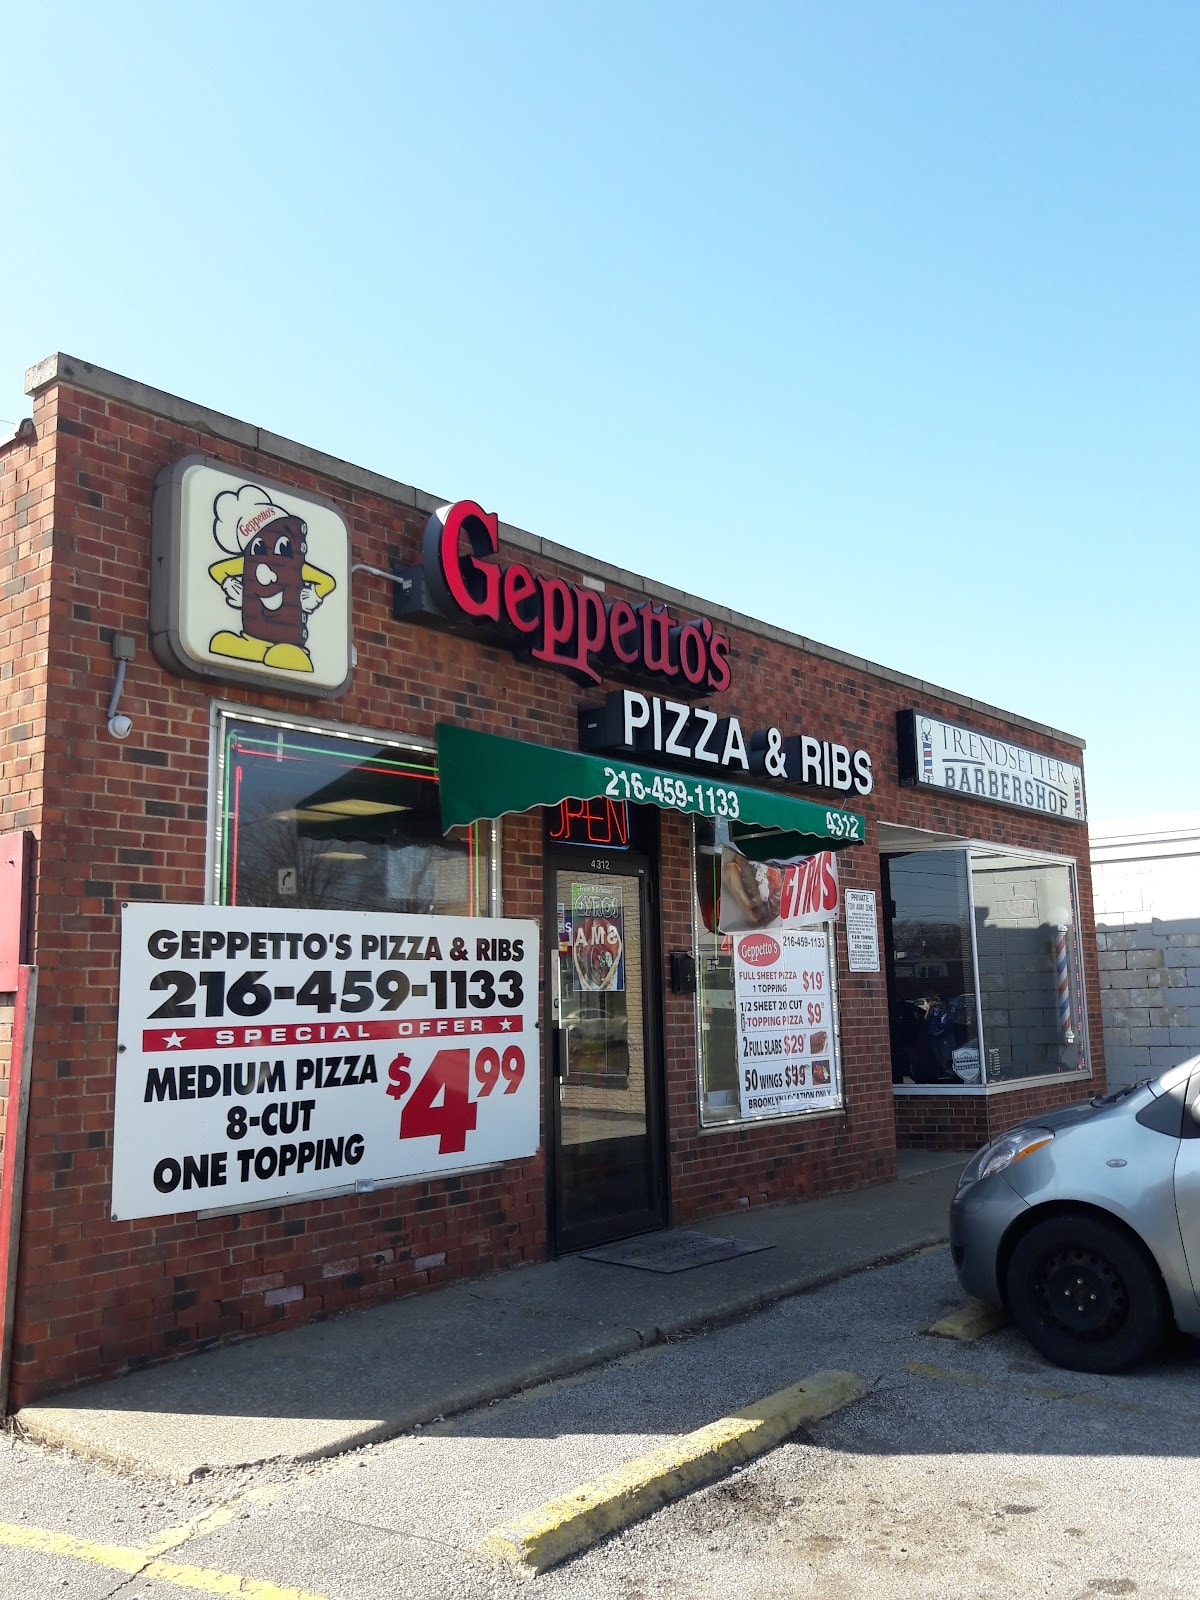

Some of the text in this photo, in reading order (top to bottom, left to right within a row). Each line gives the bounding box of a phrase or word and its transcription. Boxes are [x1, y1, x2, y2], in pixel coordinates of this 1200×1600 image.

[239, 507, 276, 537] Geppetto's
[441, 499, 732, 692] Geppetto's
[623, 689, 873, 796] PIZZA & RIBS
[938, 723, 1069, 785] TRENDSETTER
[604, 766, 740, 819] 216-459-1133
[944, 767, 1068, 816] BARBERSHOP
[825, 811, 859, 839] 4312
[590, 859, 611, 870] 4312
[780, 851, 837, 920] GYROS
[147, 929, 525, 962] GEPPETTO'S PIZZA & RIBS
[741, 940, 778, 962] Geppetto's
[782, 936, 826, 948] 216-459-1133
[739, 971, 797, 980] FULL SHEET PIZZA
[752, 984, 788, 993] 1 TOPPING
[146, 969, 525, 1020] 216-459-1133
[740, 1000, 803, 1013] 1/2 SHEET 20 CUT
[214, 1020, 485, 1046] SPECIAL OFFER
[782, 1015, 804, 1026] PIZZA
[742, 1036, 749, 1057] 2
[749, 1040, 764, 1056] FULL
[764, 1039, 783, 1055] SLABS
[144, 1054, 378, 1103] MEDIUM PIZZA
[744, 1069, 758, 1092] 50
[760, 1073, 783, 1090] WINGS
[225, 1099, 316, 1141] 8-CUT
[152, 1133, 366, 1194] ONE TOPPING
